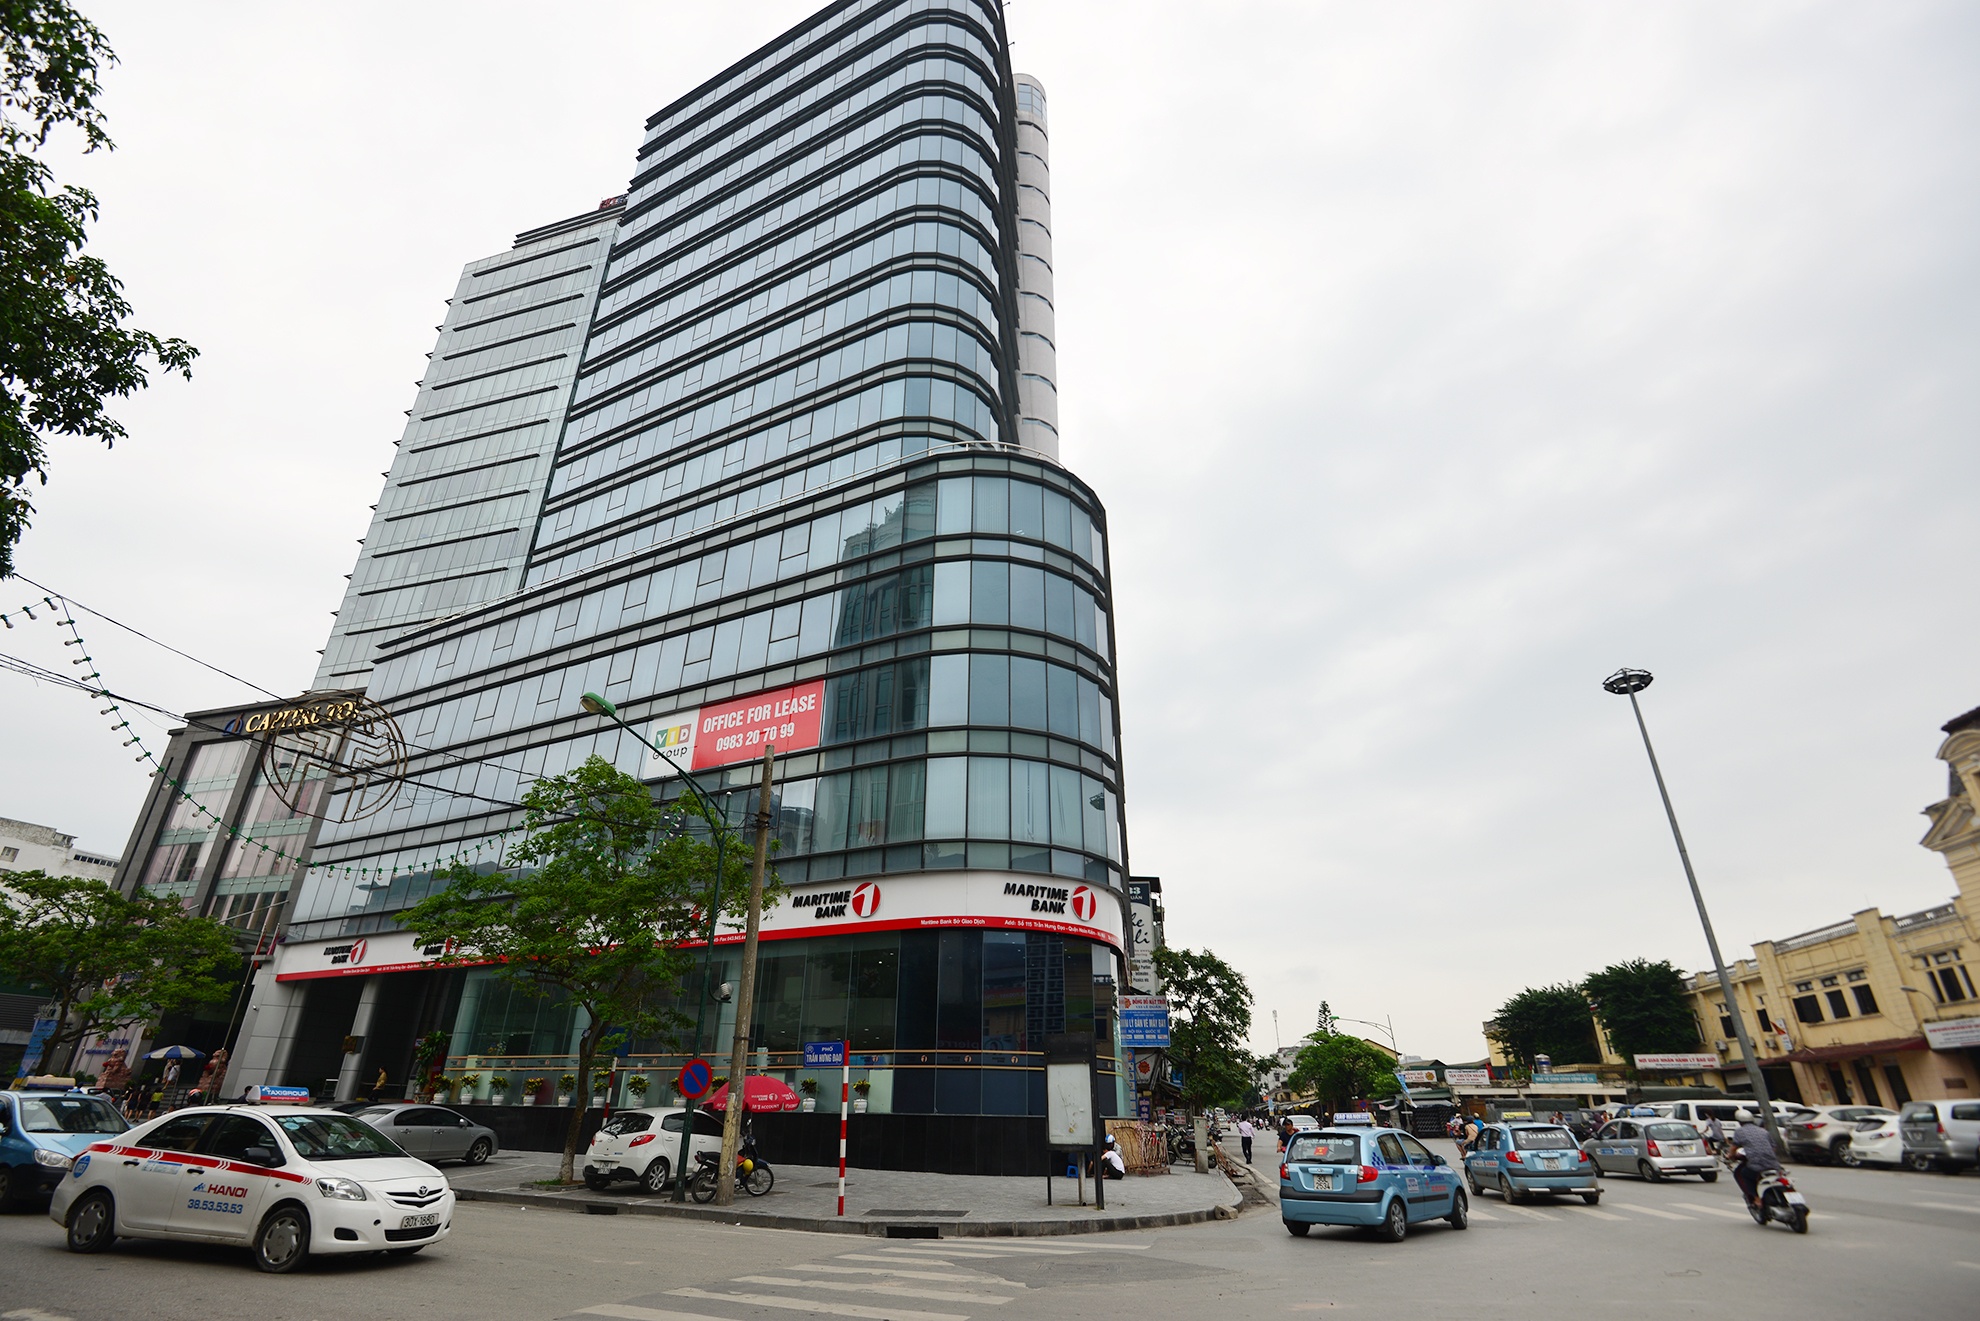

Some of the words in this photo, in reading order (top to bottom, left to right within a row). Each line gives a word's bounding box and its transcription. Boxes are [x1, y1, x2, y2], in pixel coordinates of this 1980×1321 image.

[245, 705, 321, 733] CAPITAL
[702, 710, 744, 734] OFFICE
[747, 704, 771, 724] FOR
[774, 693, 817, 719] LEASE
[656, 728, 689, 746] VID
[716, 734, 743, 752] 0983
[745, 731, 760, 746] 20
[762, 726, 777, 741] 70
[779, 722, 795, 739] 99
[652, 746, 688, 761] Group
[792, 890, 851, 908] MARITIME
[1003, 882, 1069, 901] MARITIME
[814, 904, 847, 919] BANK
[1030, 899, 1066, 914] BANK
[806, 1051, 818, 1063] TRẦN
[819, 1052, 832, 1063] HƯNG
[207, 1183, 249, 1198] HANOI
[187, 1198, 244, 1214] 38.53.53.53
